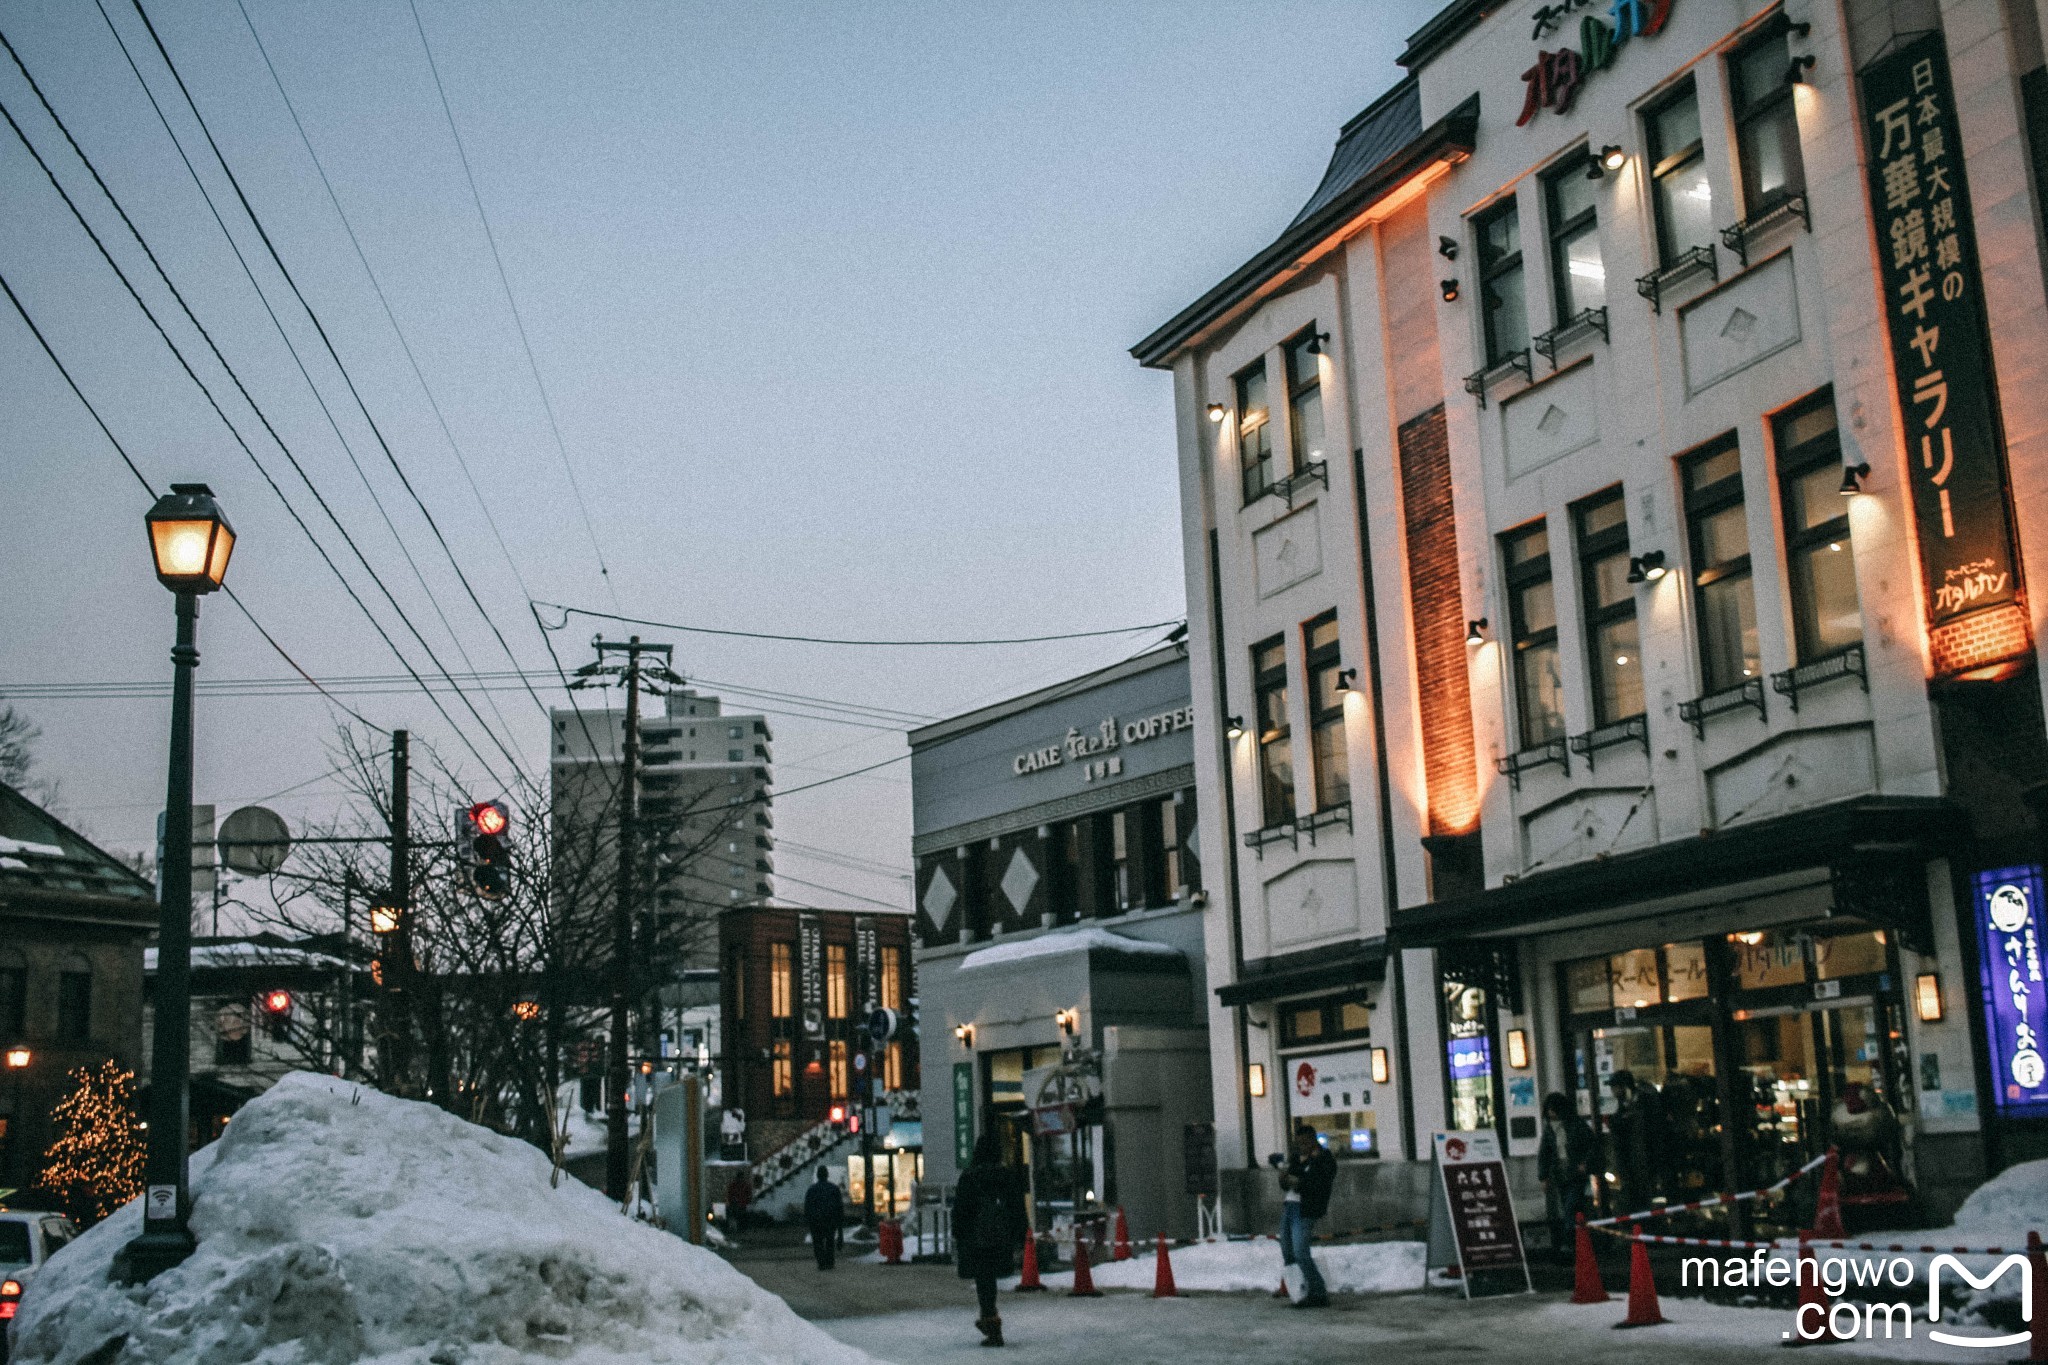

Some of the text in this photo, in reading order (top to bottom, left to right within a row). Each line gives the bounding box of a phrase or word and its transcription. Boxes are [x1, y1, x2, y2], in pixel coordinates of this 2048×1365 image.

[1912, 57, 1964, 301] 日本最大規模の
[1874, 97, 1955, 537] 万華鏡ギャラリー
[1013, 744, 1061, 775] CAKE
